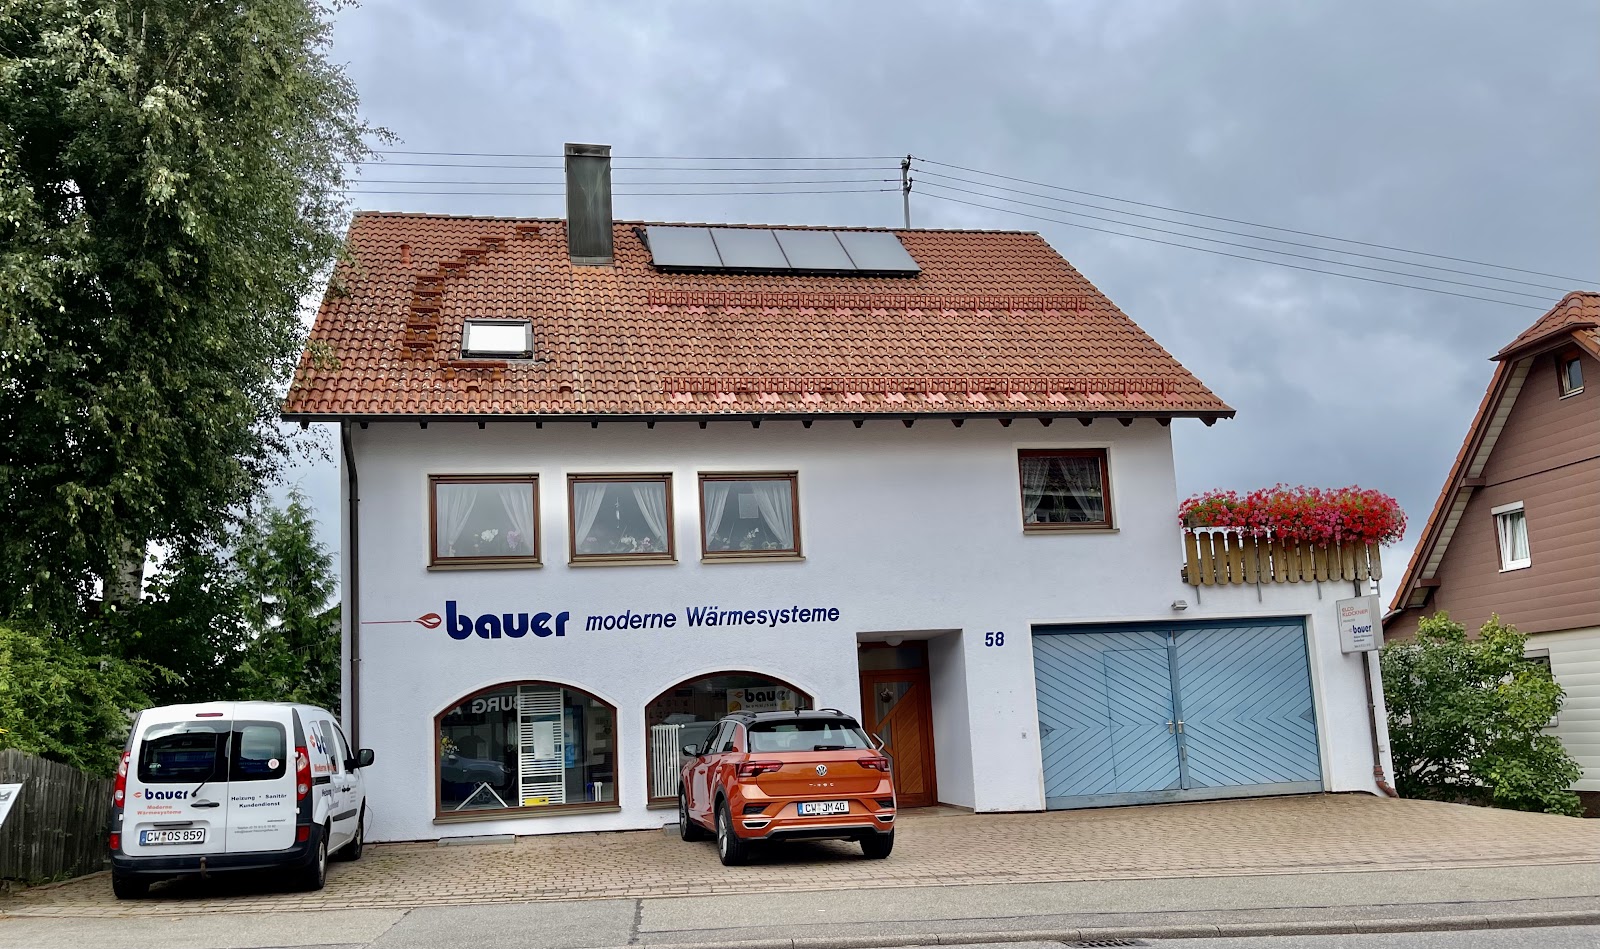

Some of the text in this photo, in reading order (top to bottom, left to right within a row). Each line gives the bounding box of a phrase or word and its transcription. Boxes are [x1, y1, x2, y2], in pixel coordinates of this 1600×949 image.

[445, 600, 570, 640] bauer
[585, 605, 840, 631] moderne Wärmesysteme
[1352, 624, 1372, 634] bauer
[985, 631, 1005, 647] 58
[744, 688, 791, 703] bauer
[144, 788, 188, 800] bauer
[805, 802, 845, 813] CW JM 40
[146, 830, 203, 842] CW OS 859
